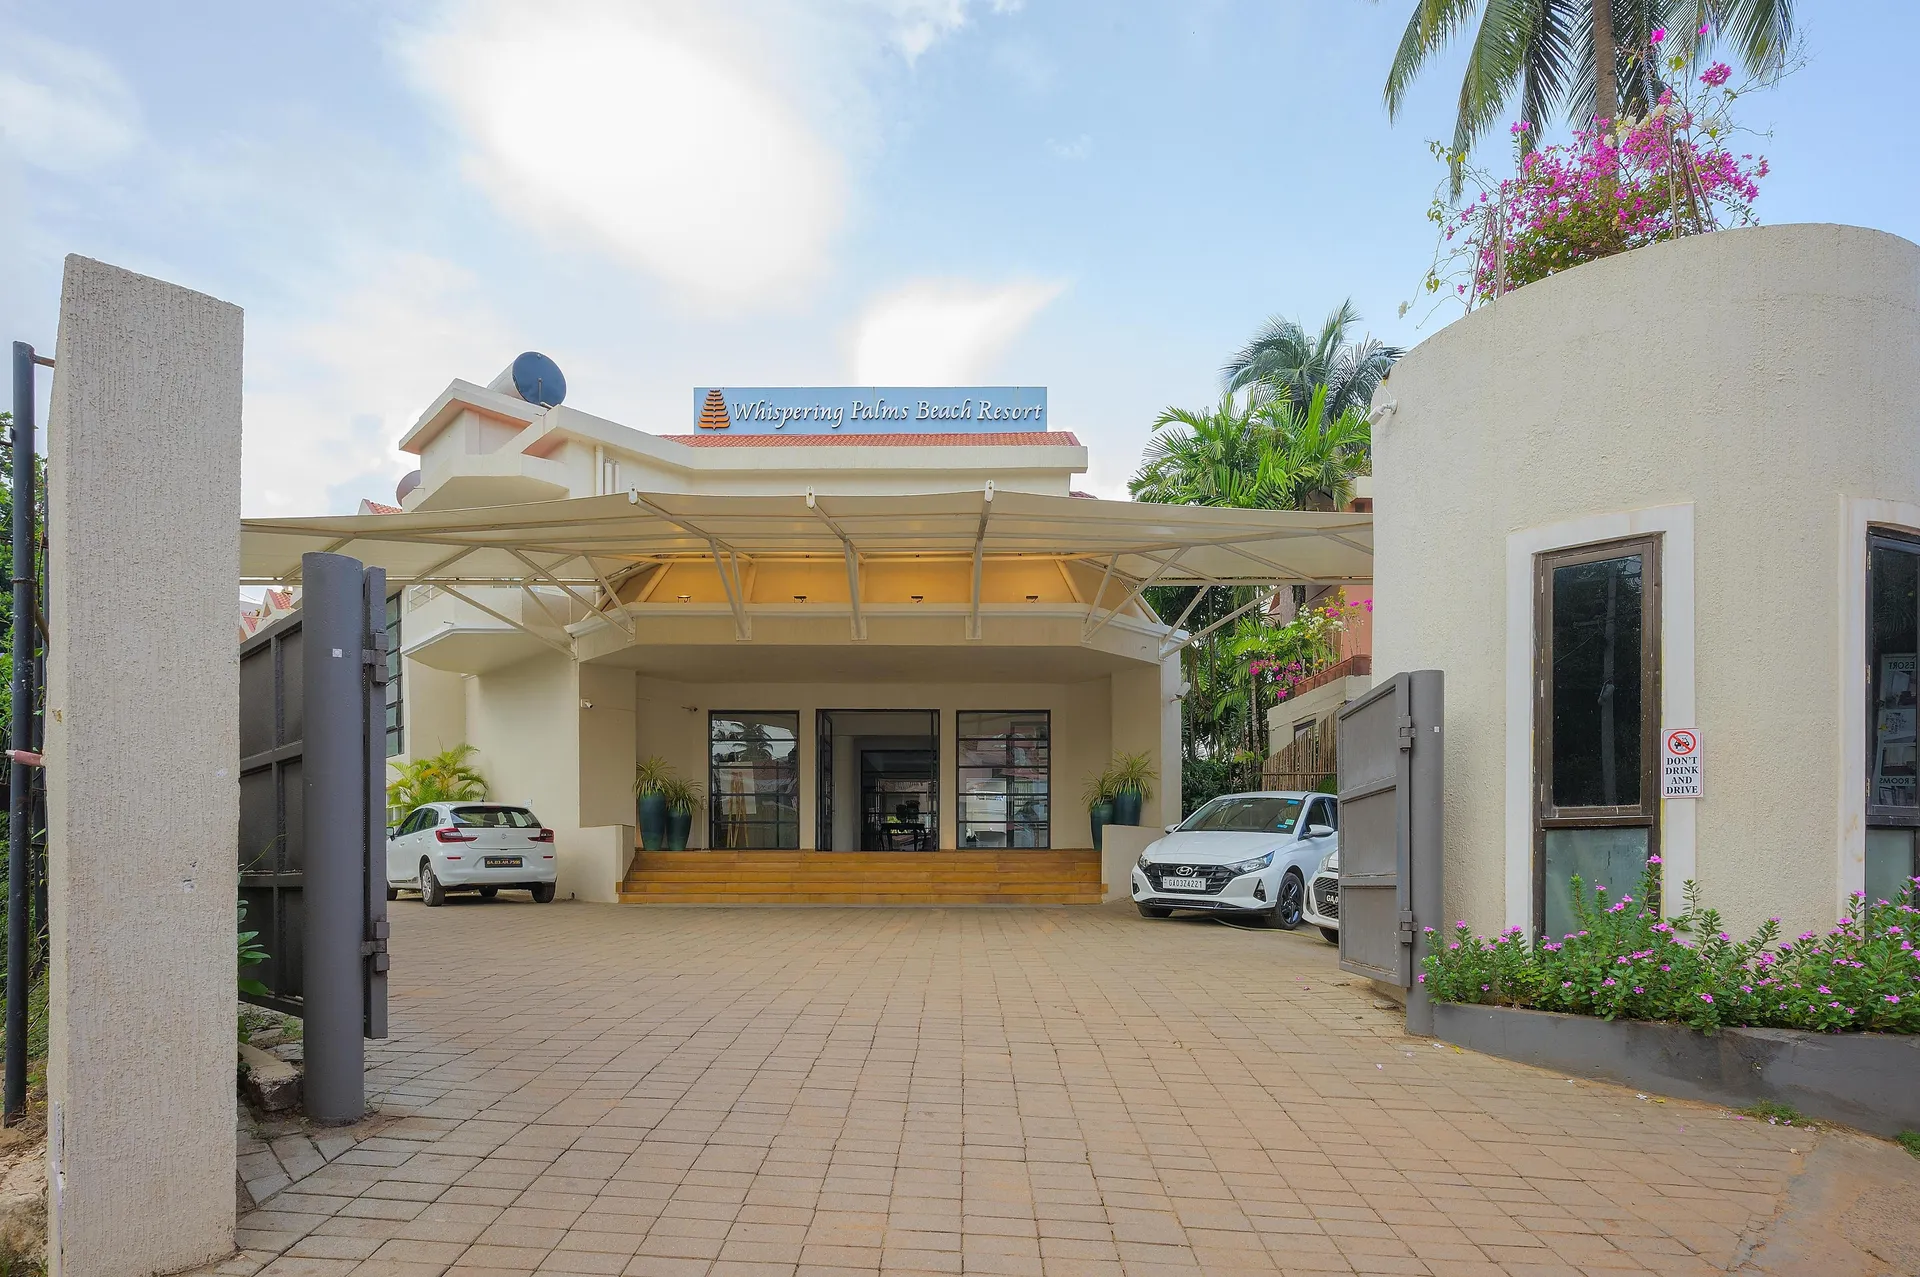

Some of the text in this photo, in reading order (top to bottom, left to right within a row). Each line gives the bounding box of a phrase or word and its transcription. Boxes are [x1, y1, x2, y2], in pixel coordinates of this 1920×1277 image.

[732, 398, 1043, 429] Whispering Palms Beach Resort
[1667, 757, 1697, 765] DON'T
[1665, 767, 1699, 775] DRINK
[1671, 776, 1692, 784] AND
[1666, 786, 1698, 794] DRIVE
